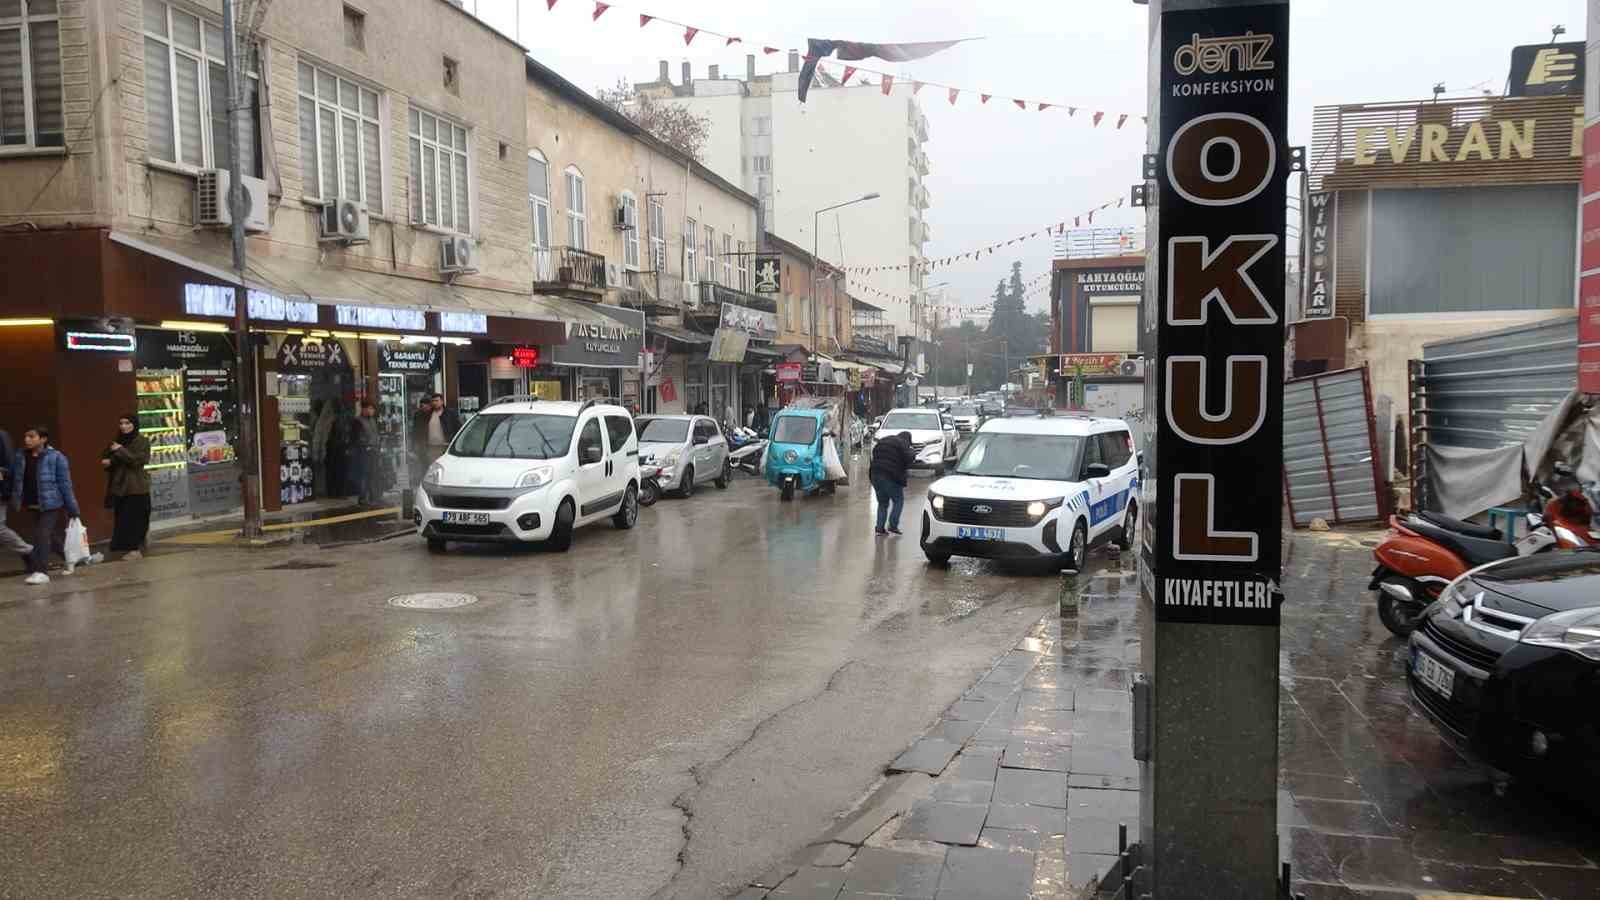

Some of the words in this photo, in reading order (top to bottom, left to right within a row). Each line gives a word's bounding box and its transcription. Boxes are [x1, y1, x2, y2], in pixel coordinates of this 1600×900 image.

[1174, 31, 1274, 75] deniz
[1353, 119, 1536, 166] EVRAN
[1165, 112, 1279, 562] OKUL
